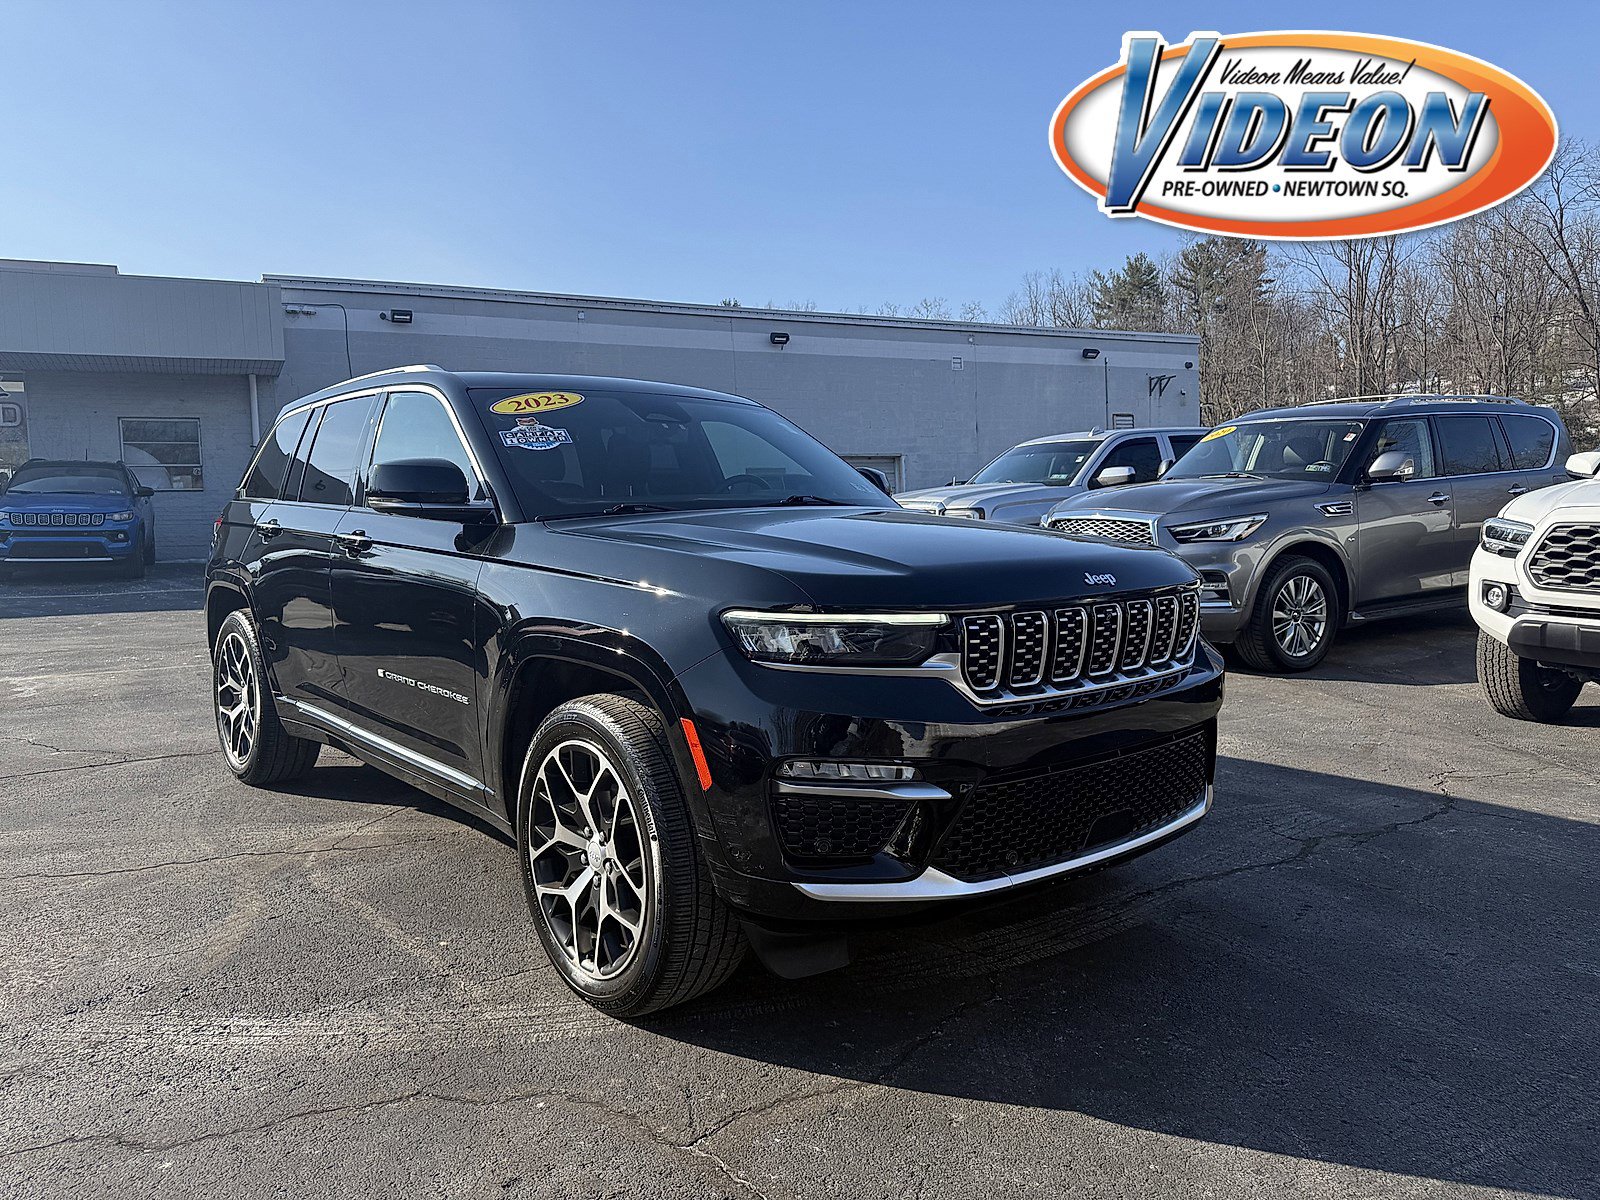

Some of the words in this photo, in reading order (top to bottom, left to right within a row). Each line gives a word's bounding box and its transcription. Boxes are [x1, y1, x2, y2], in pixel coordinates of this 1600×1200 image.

[507, 393, 570, 412] 2023
[1084, 572, 1117, 586] Jeep
[385, 671, 416, 687] GRAND
[416, 681, 470, 705] CHEROKEE
